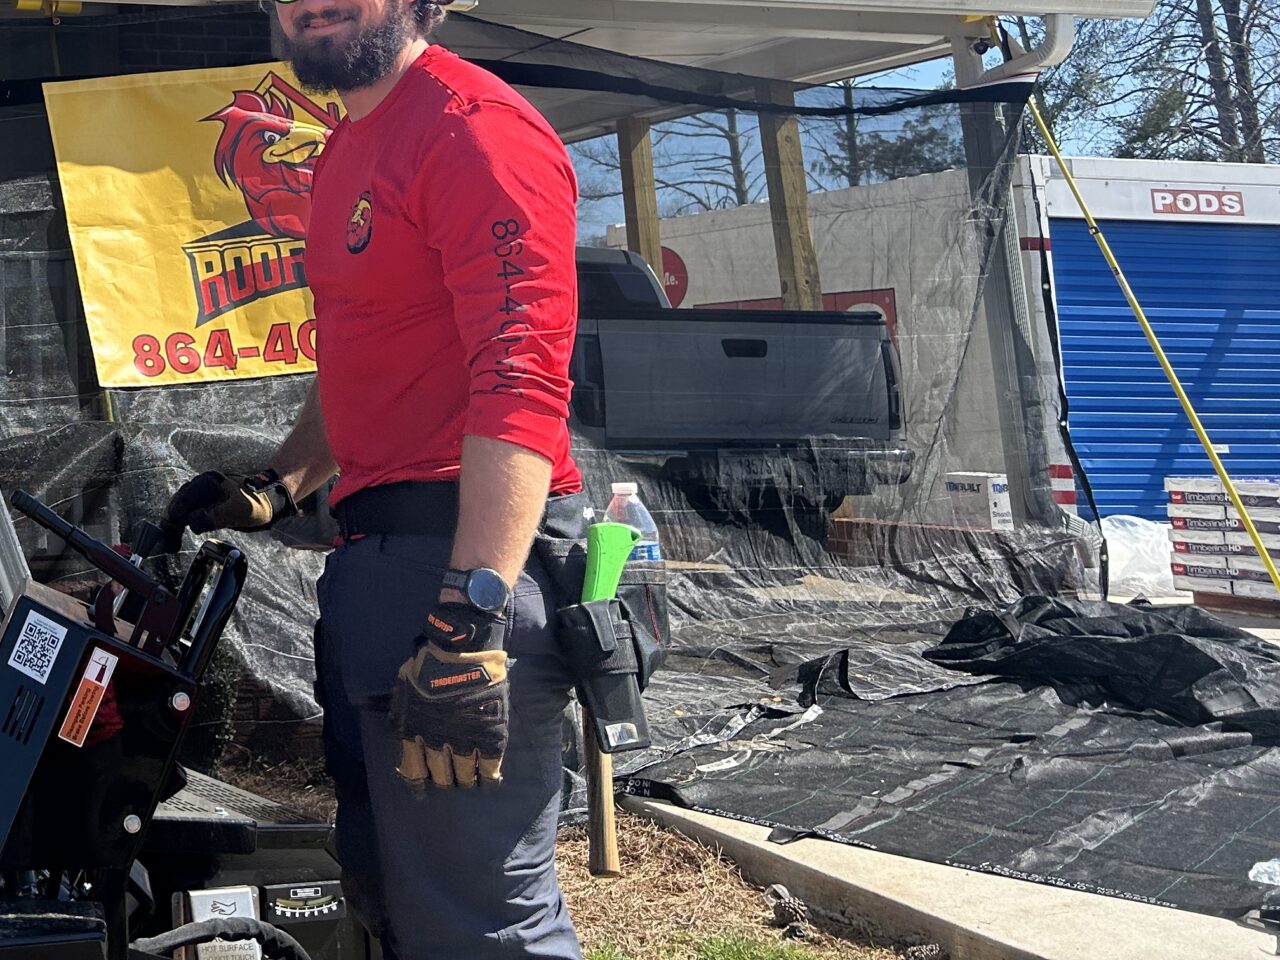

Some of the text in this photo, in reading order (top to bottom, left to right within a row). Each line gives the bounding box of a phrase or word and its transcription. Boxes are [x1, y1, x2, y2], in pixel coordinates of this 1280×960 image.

[1153, 192, 1241, 213] PODS
[1224, 494, 1233, 502] H
[1226, 520, 1239, 528] HD
[1226, 568, 1239, 576] HD
[430, 670, 481, 688] TRADEMASTER
[77, 686, 91, 709] Parking
[201, 943, 254, 953] HOT SURFACE
